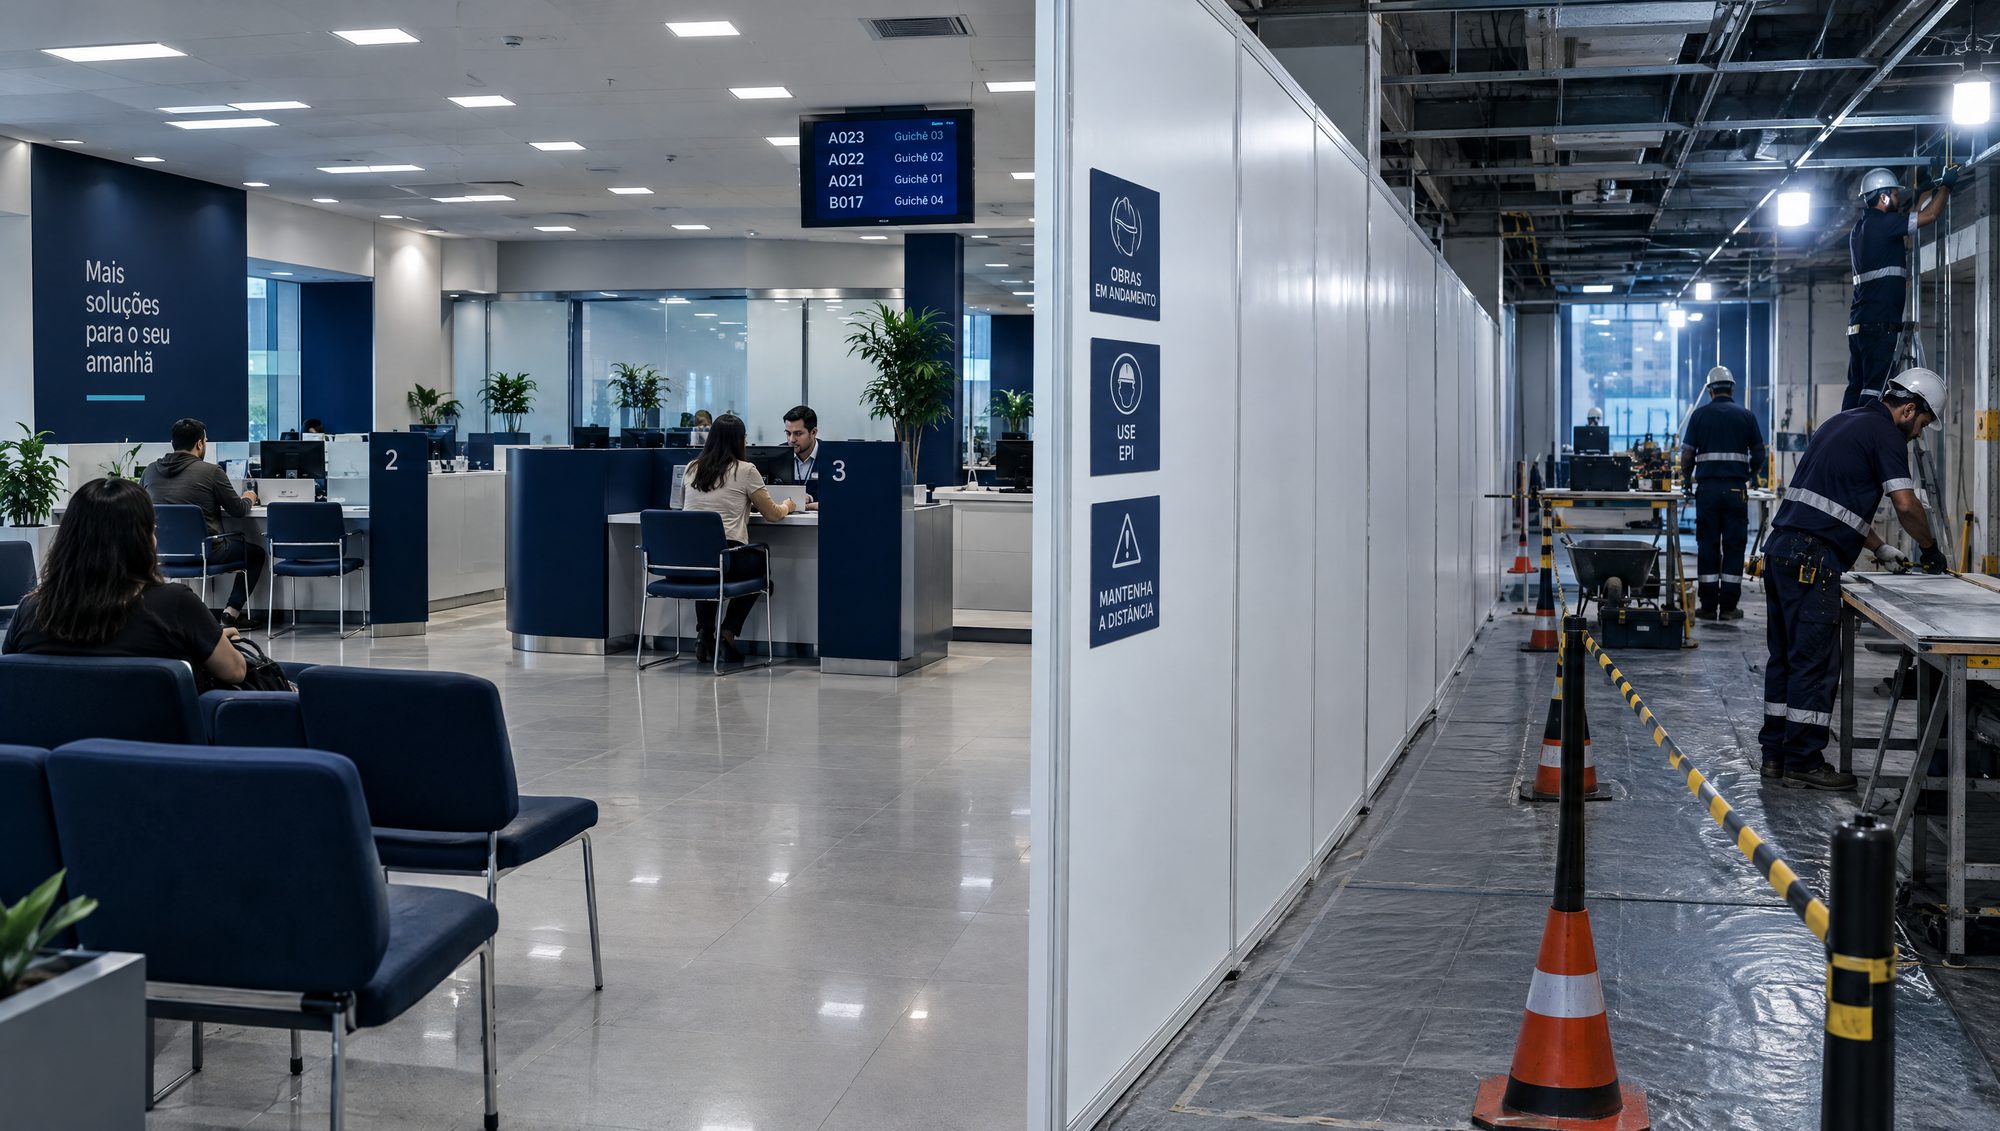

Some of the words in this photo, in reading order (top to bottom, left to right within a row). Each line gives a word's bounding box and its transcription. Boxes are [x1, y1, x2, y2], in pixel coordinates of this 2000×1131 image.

[828, 131, 865, 144] A023
[930, 130, 944, 140] 03
[828, 152, 865, 166] A022
[930, 151, 944, 162] 02
[828, 174, 863, 187] A021
[930, 173, 943, 184] 01
[829, 195, 864, 209] B017
[930, 195, 944, 205] 04
[86, 259, 125, 284] Mais
[1110, 266, 1142, 287] OBRAS
[86, 289, 160, 320] soluções
[1095, 283, 1108, 299] EM
[1108, 285, 1157, 307] ANDAMENTO
[86, 324, 123, 347] para
[127, 326, 139, 344] o
[142, 327, 170, 345] seu
[86, 350, 153, 373] amanhã
[1117, 424, 1136, 440] USE
[385, 449, 398, 471] 2
[1119, 445, 1134, 461] EPI
[832, 459, 846, 482] 3
[1099, 580, 1153, 608] MANTENHA
[1098, 615, 1106, 631] A
